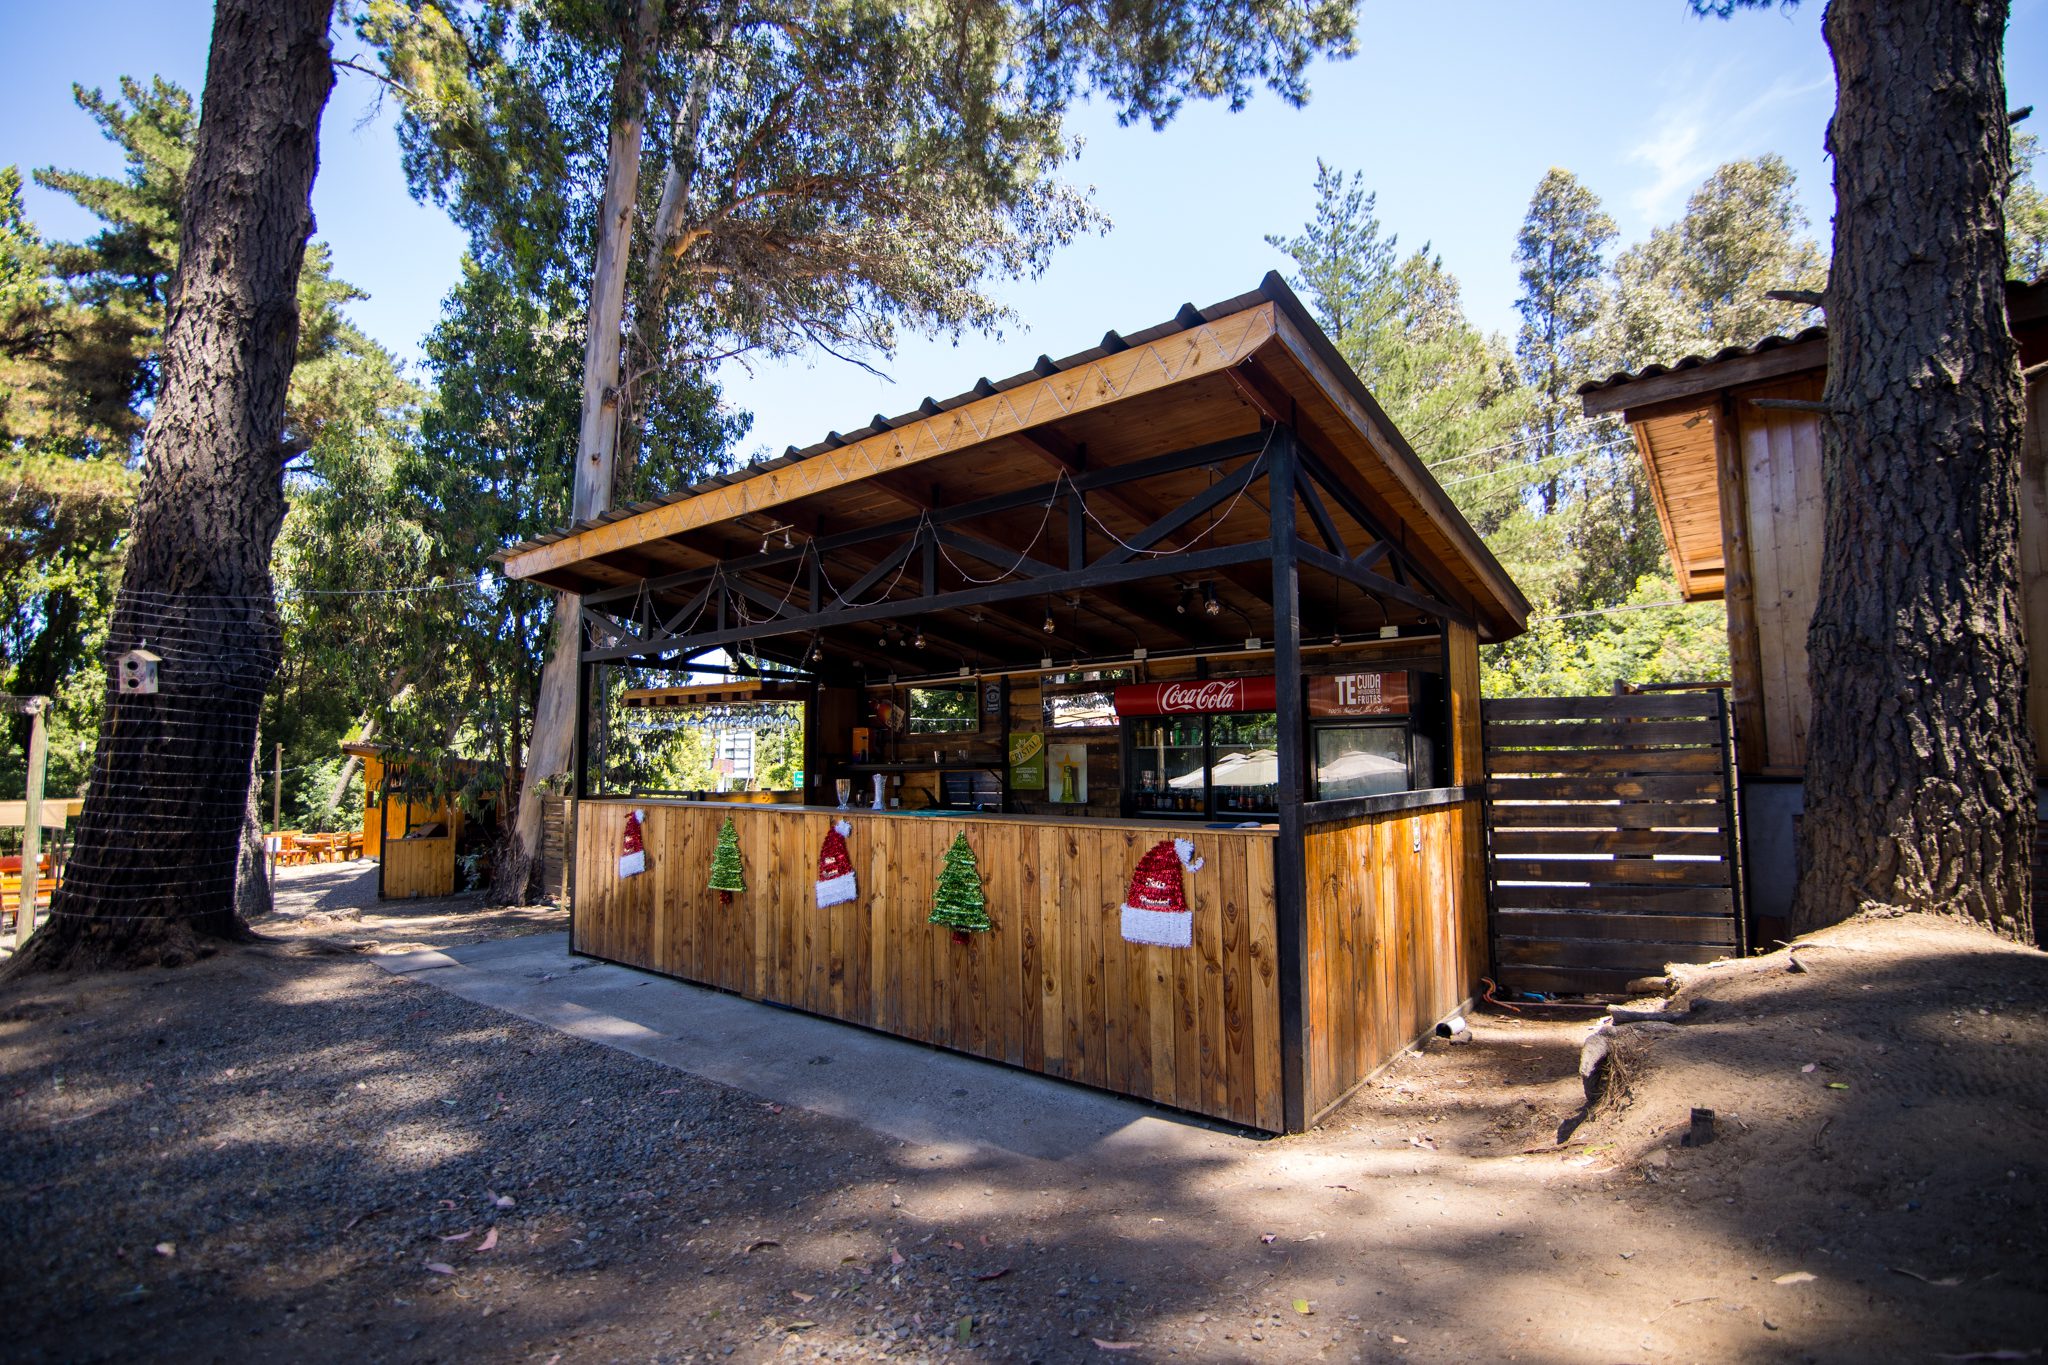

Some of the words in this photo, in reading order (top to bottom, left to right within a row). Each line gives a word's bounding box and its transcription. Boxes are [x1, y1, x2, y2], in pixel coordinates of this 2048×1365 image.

[1335, 676, 1357, 705] TE
[1357, 674, 1381, 689] CUIDA
[1162, 681, 1239, 711] Coca-Cola
[1357, 695, 1382, 704] FRUTAS
[1010, 740, 1039, 762] CRISTAL
